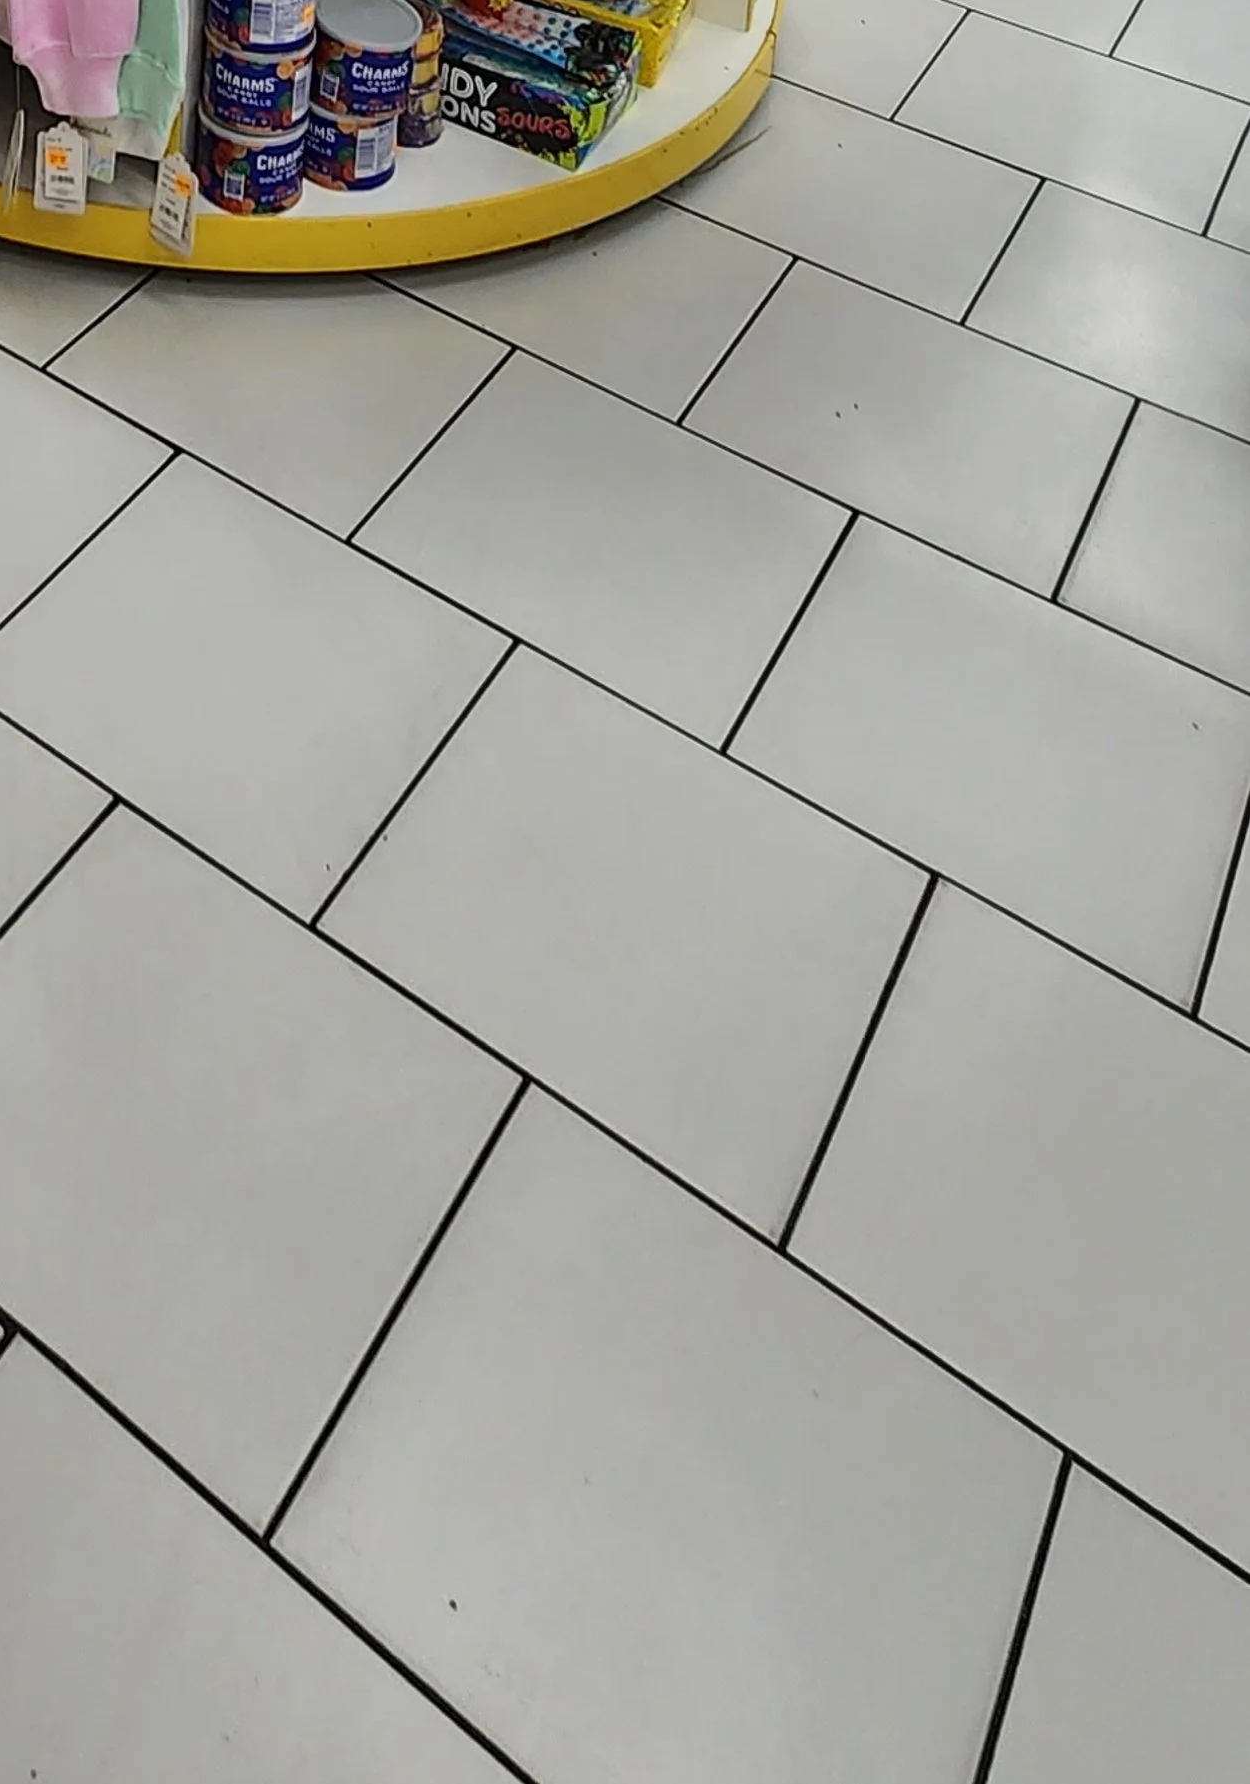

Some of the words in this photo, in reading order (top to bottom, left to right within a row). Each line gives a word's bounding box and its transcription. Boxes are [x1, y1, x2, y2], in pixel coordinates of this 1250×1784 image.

[216, 62, 276, 93] CHARMS
[351, 60, 410, 80] CHARMS
[496, 107, 574, 141] SOURS
[256, 139, 305, 171] CHARM
